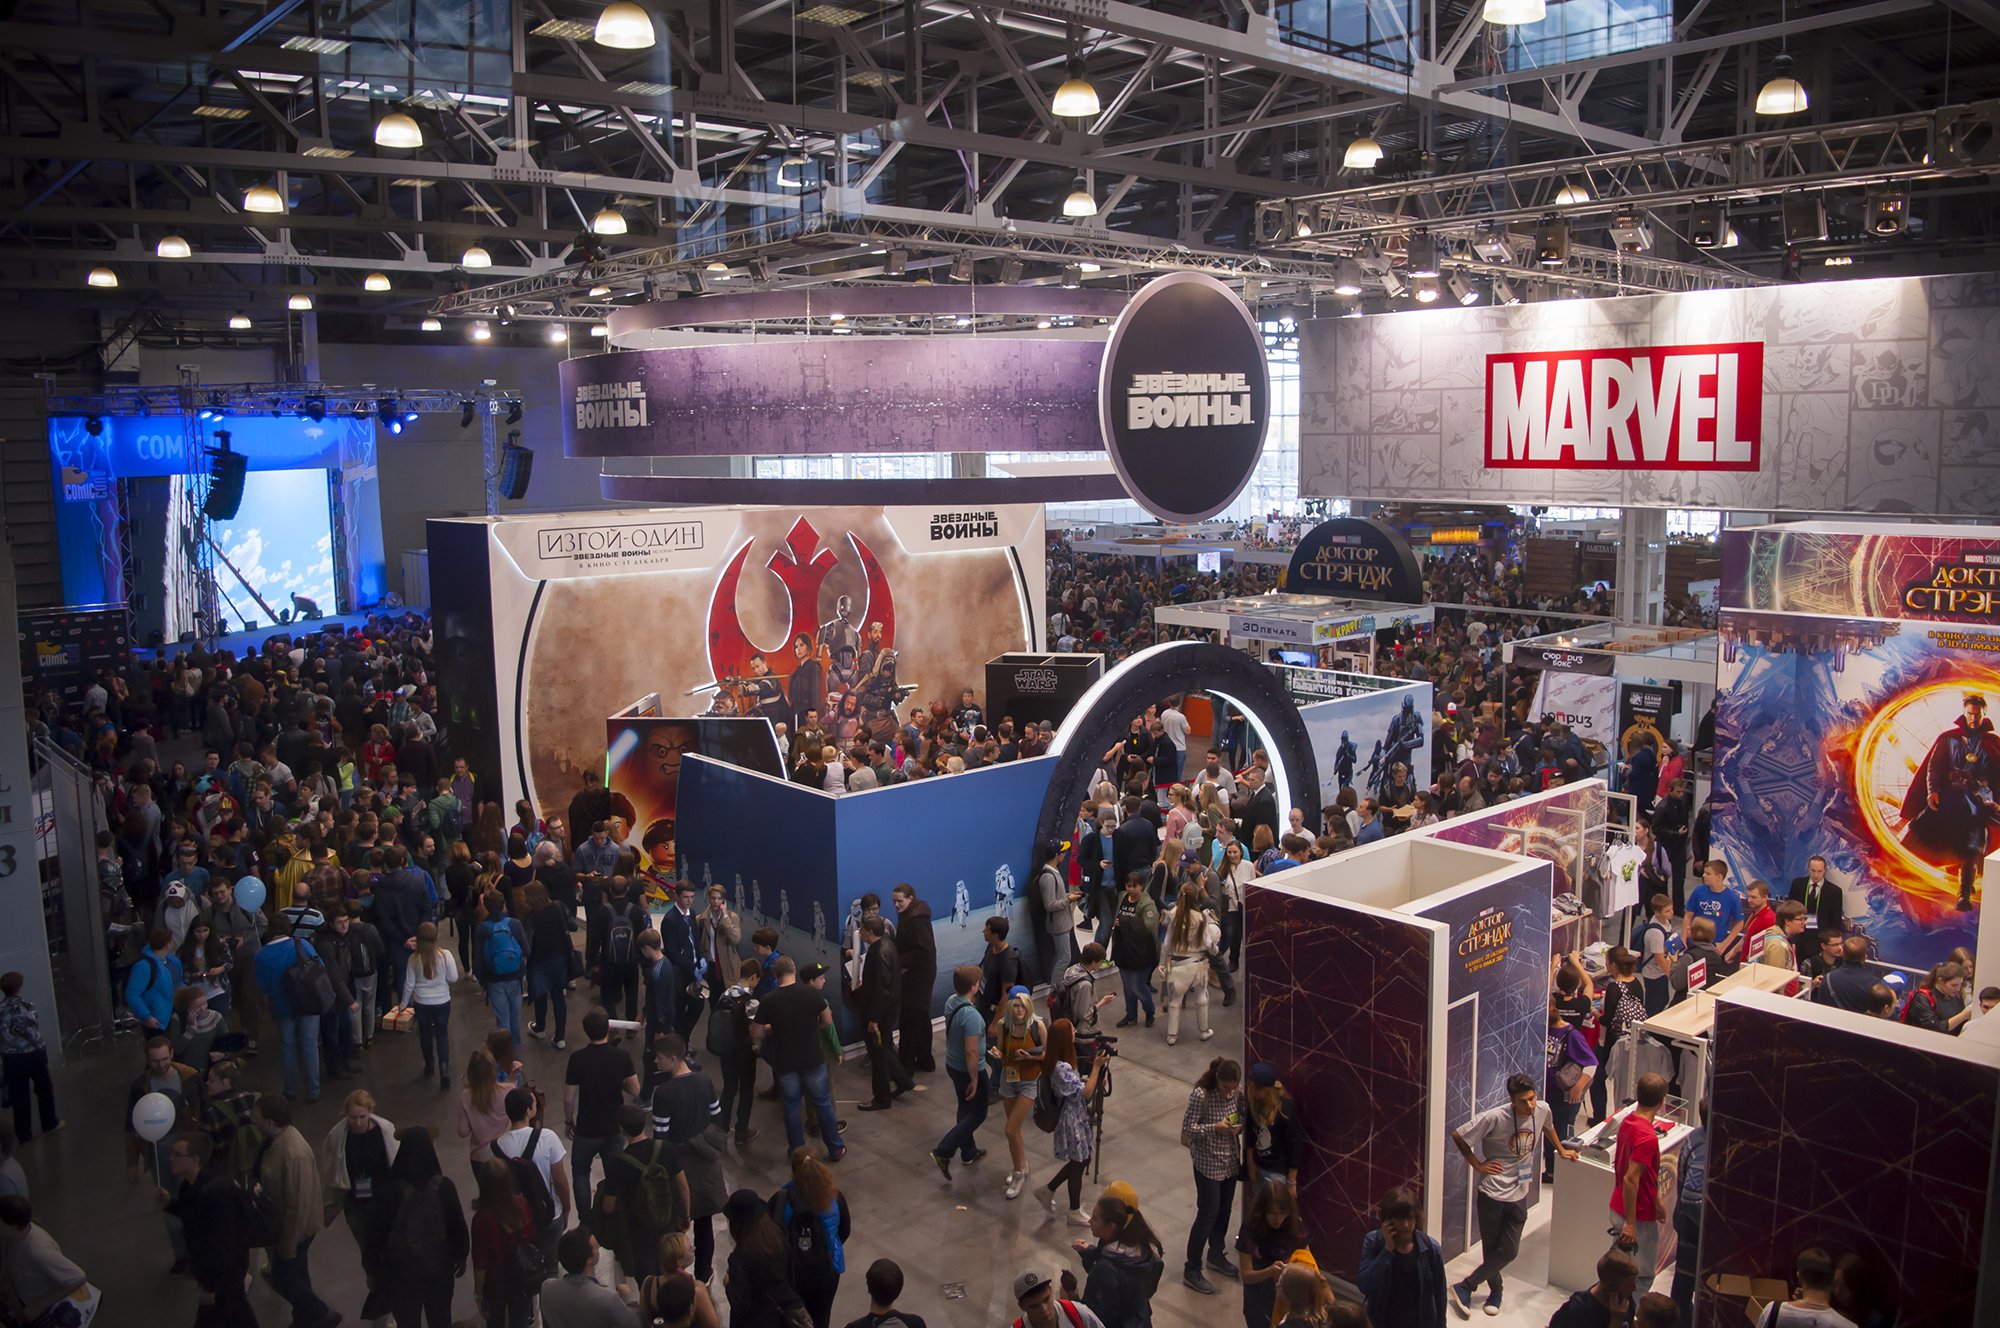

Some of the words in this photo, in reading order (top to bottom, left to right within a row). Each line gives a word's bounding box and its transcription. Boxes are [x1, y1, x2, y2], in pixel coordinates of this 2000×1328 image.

[1491, 352, 1752, 462] MARVEL
[547, 526, 696, 552] ИЗГОЙ-ОДИН
[1316, 545, 1379, 563] ДОКТОР
[1300, 562, 1393, 591] СТРЭНДЖ
[1242, 622, 1259, 633] 3D
[1261, 626, 1298, 637] ПЕЧАТЬ
[1937, 632, 1965, 641] КИНО
[1975, 633, 1987, 642] 28
[1015, 668, 1057, 680] STAR
[1015, 679, 1057, 690] WARS
[1469, 911, 1504, 939] ДОКТОР
[1458, 922, 1512, 956] СТРЭНДЖ
